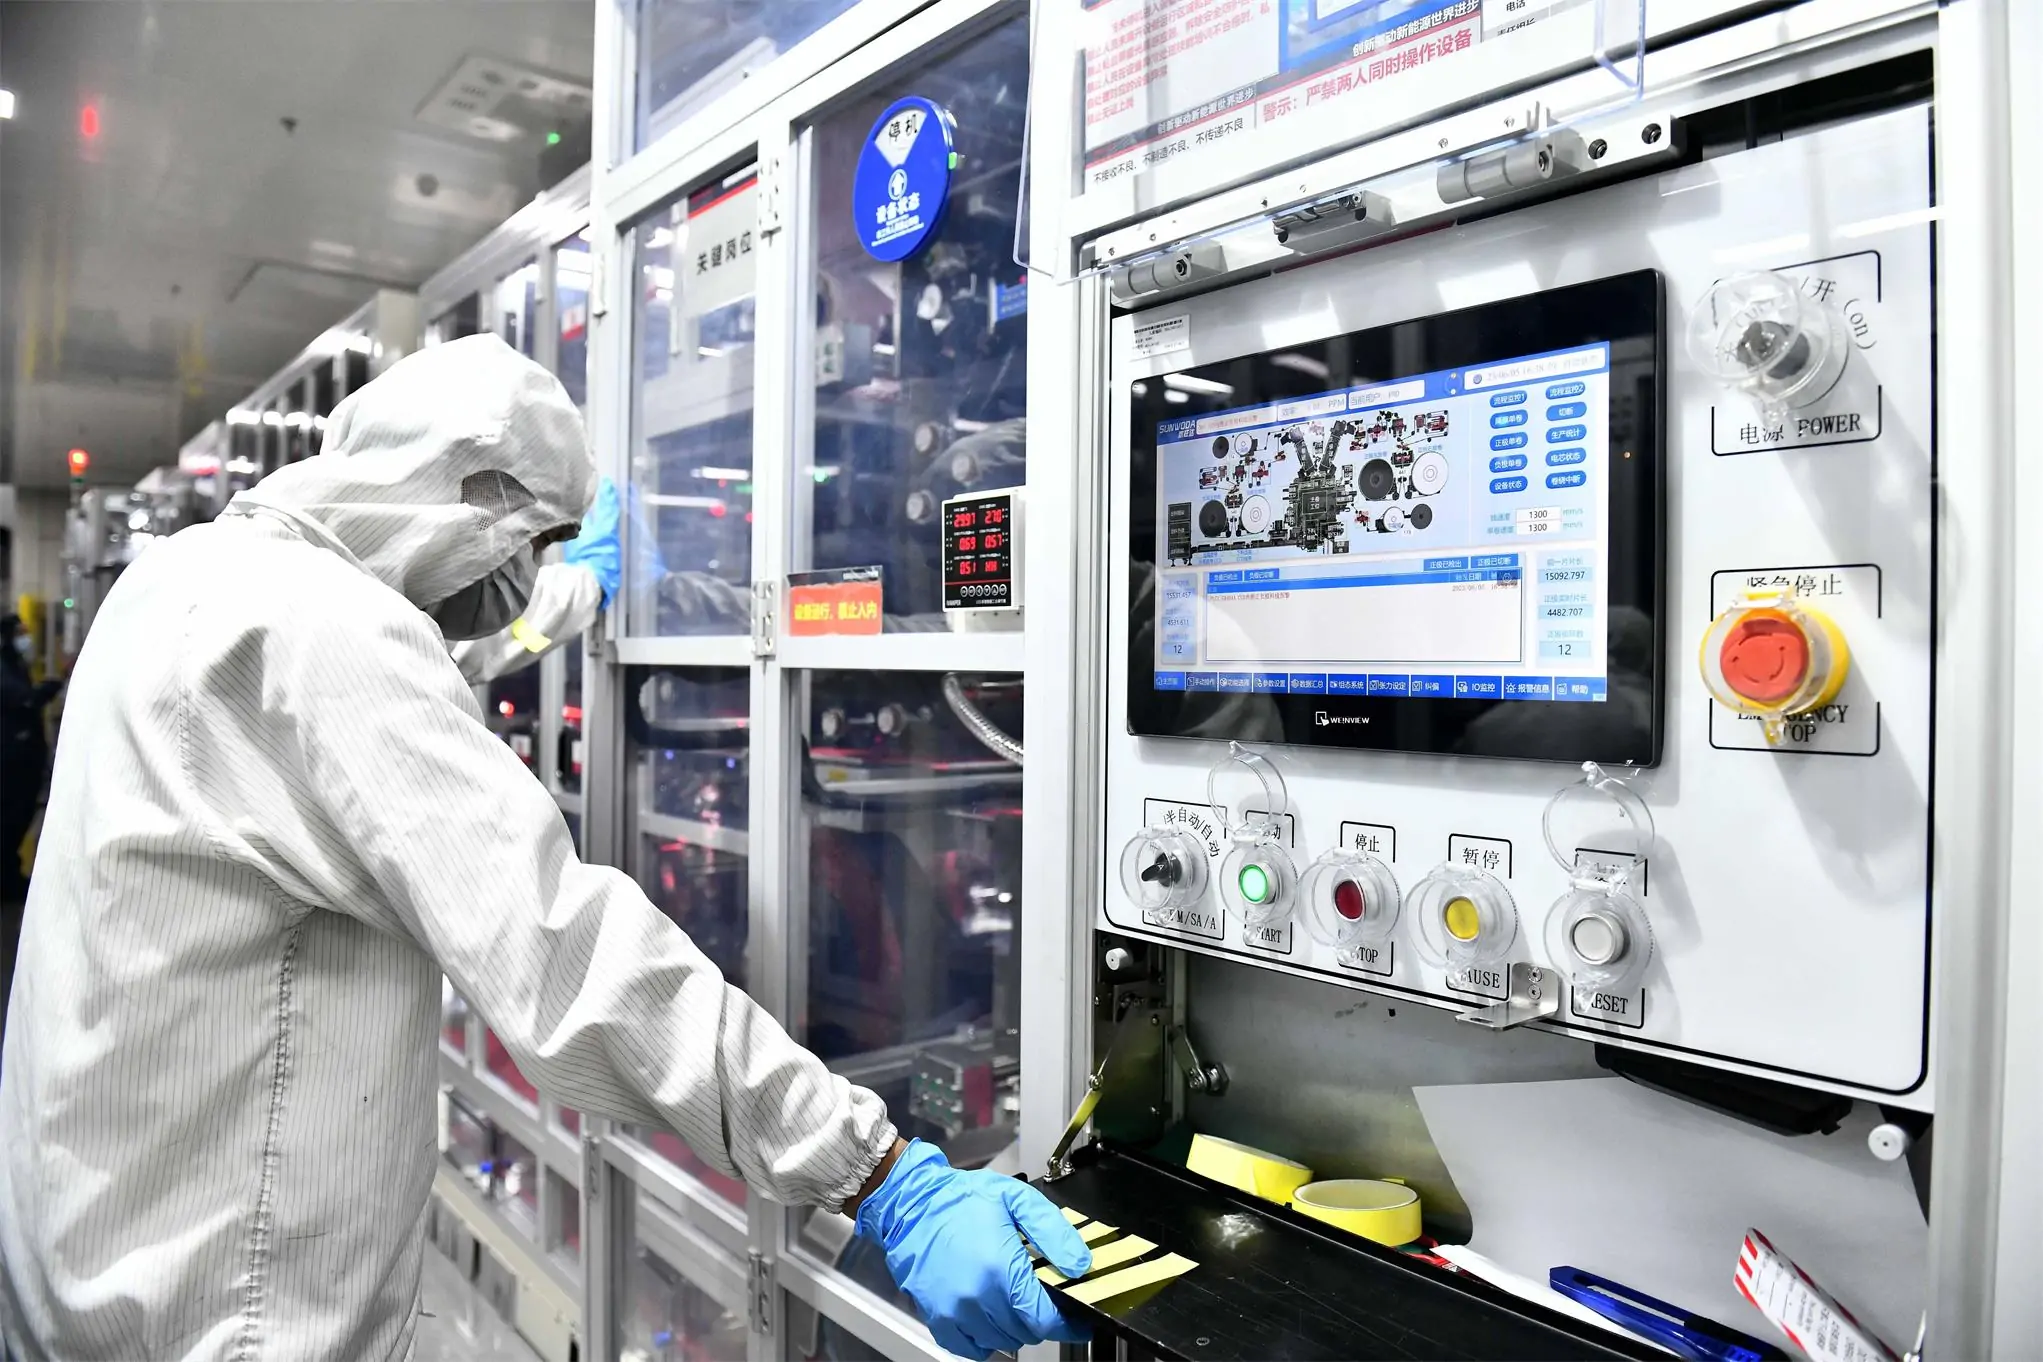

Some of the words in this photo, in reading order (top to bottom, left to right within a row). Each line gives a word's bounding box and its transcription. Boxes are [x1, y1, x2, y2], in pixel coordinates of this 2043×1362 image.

[1159, 420, 1196, 434] SUNWODA
[1797, 413, 1862, 438] POWER
[1529, 509, 1548, 519] 1300
[1528, 522, 1548, 532] 1300
[1545, 571, 1585, 581] 15092.797
[1547, 607, 1584, 618] 4482.707
[1173, 645, 1183, 655] 12
[1557, 643, 1573, 657] 12
[1517, 682, 1550, 694] 报警信息
[1355, 833, 1381, 853] 停止
[1462, 847, 1500, 870] 暂停
[1591, 992, 1629, 1015] ESET
